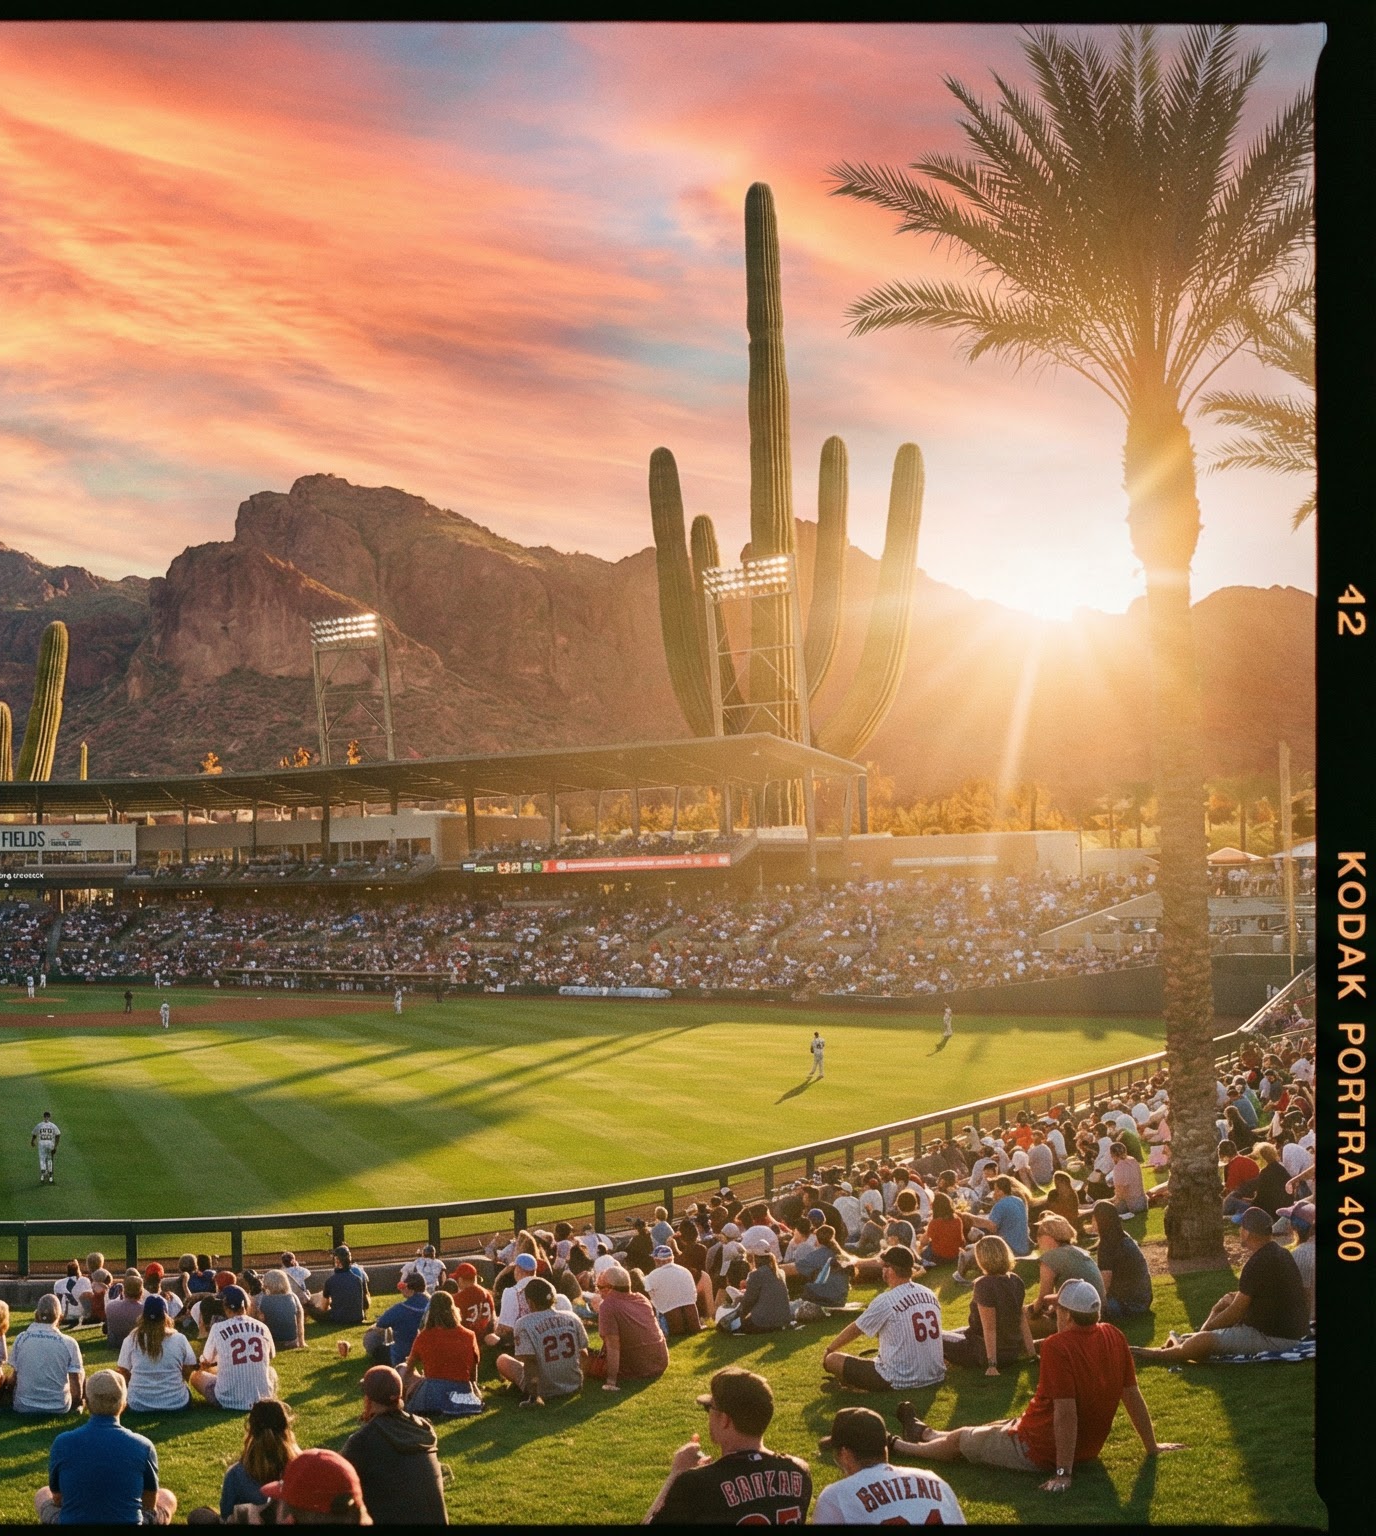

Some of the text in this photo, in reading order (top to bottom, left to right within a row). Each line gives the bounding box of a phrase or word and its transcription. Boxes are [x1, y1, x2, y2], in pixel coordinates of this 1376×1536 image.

[2, 831, 45, 848] FIELDS
[911, 1310, 940, 1343] 63
[230, 1336, 264, 1365] 23
[542, 1332, 575, 1363] 23
